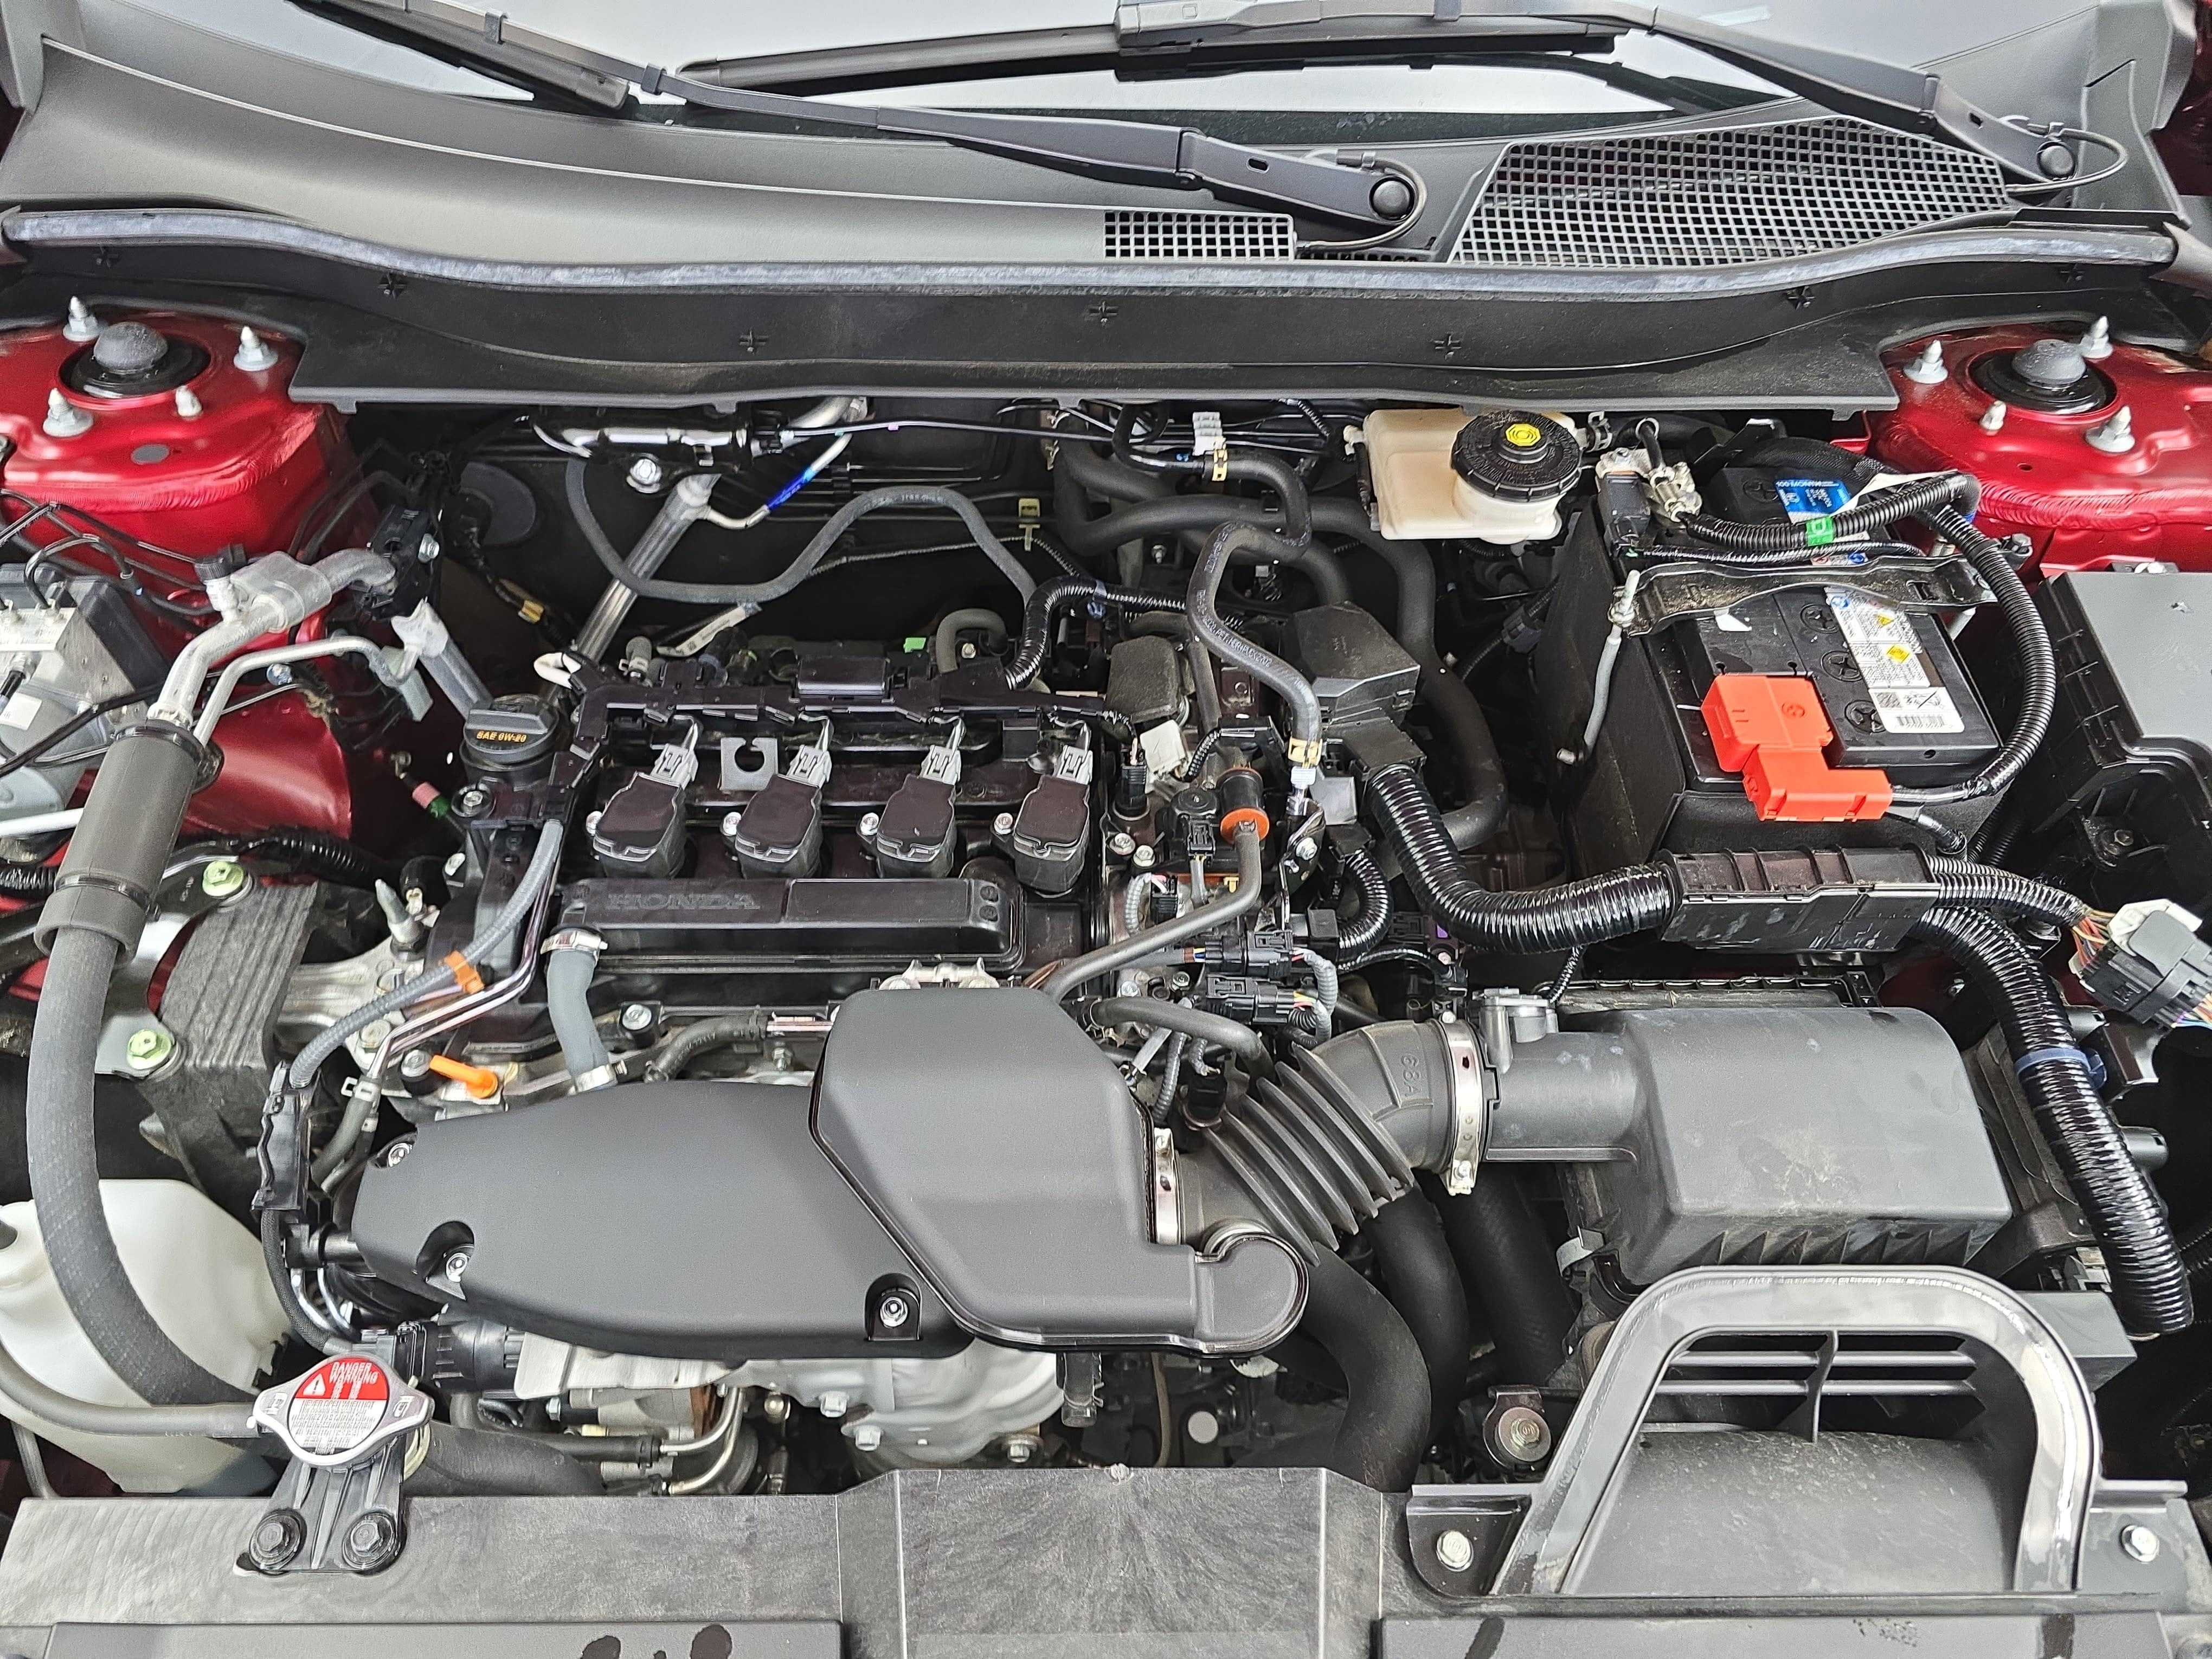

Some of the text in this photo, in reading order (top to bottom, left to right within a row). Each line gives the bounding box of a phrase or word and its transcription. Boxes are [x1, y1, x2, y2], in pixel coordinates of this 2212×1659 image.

[476, 730, 527, 743] SAE 0W-20
[605, 893, 761, 910] HONDA
[331, 1361, 372, 1373] DANGER
[329, 1371, 378, 1385] WARNING
